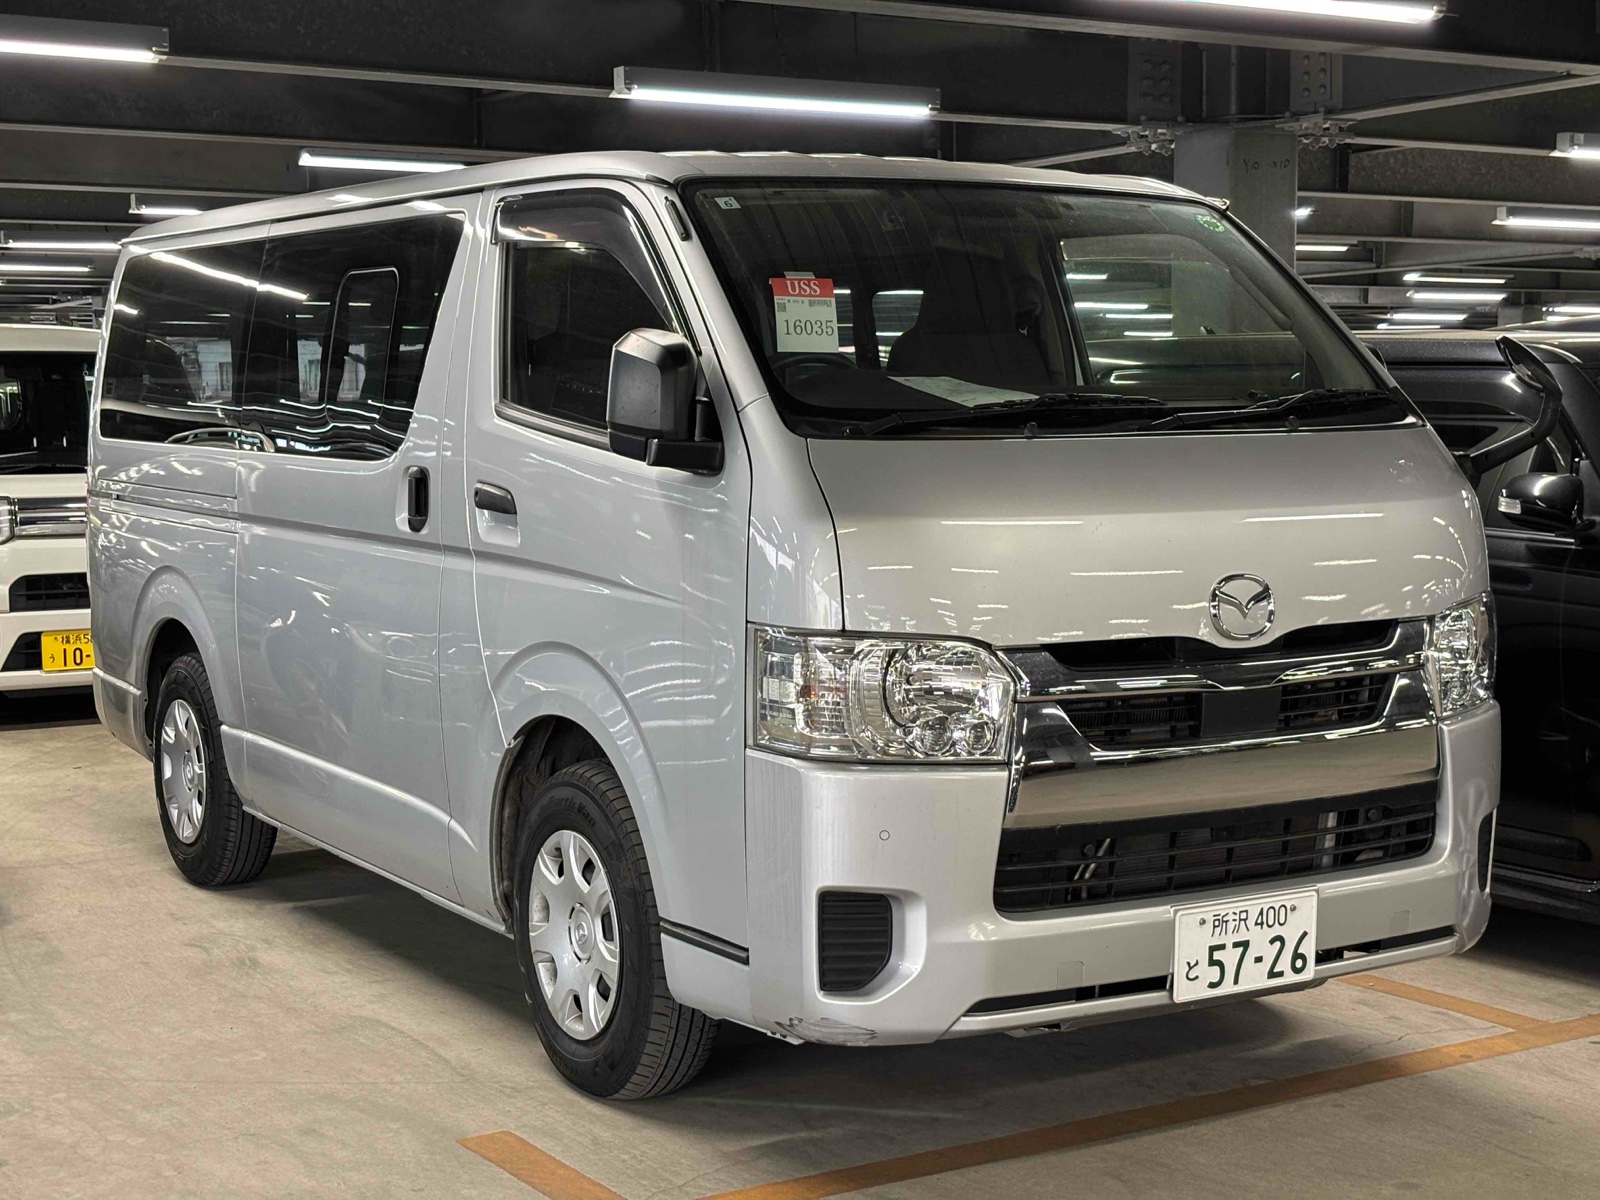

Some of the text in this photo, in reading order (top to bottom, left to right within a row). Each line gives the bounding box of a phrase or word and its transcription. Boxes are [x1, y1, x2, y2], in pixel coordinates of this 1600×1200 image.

[785, 280, 821, 295] USS
[784, 319, 834, 337] 16035
[61, 634, 82, 645] 横浜
[49, 653, 55, 663] う
[1211, 904, 1288, 938] 所沢 400
[1185, 930, 1309, 989] と 57-26
